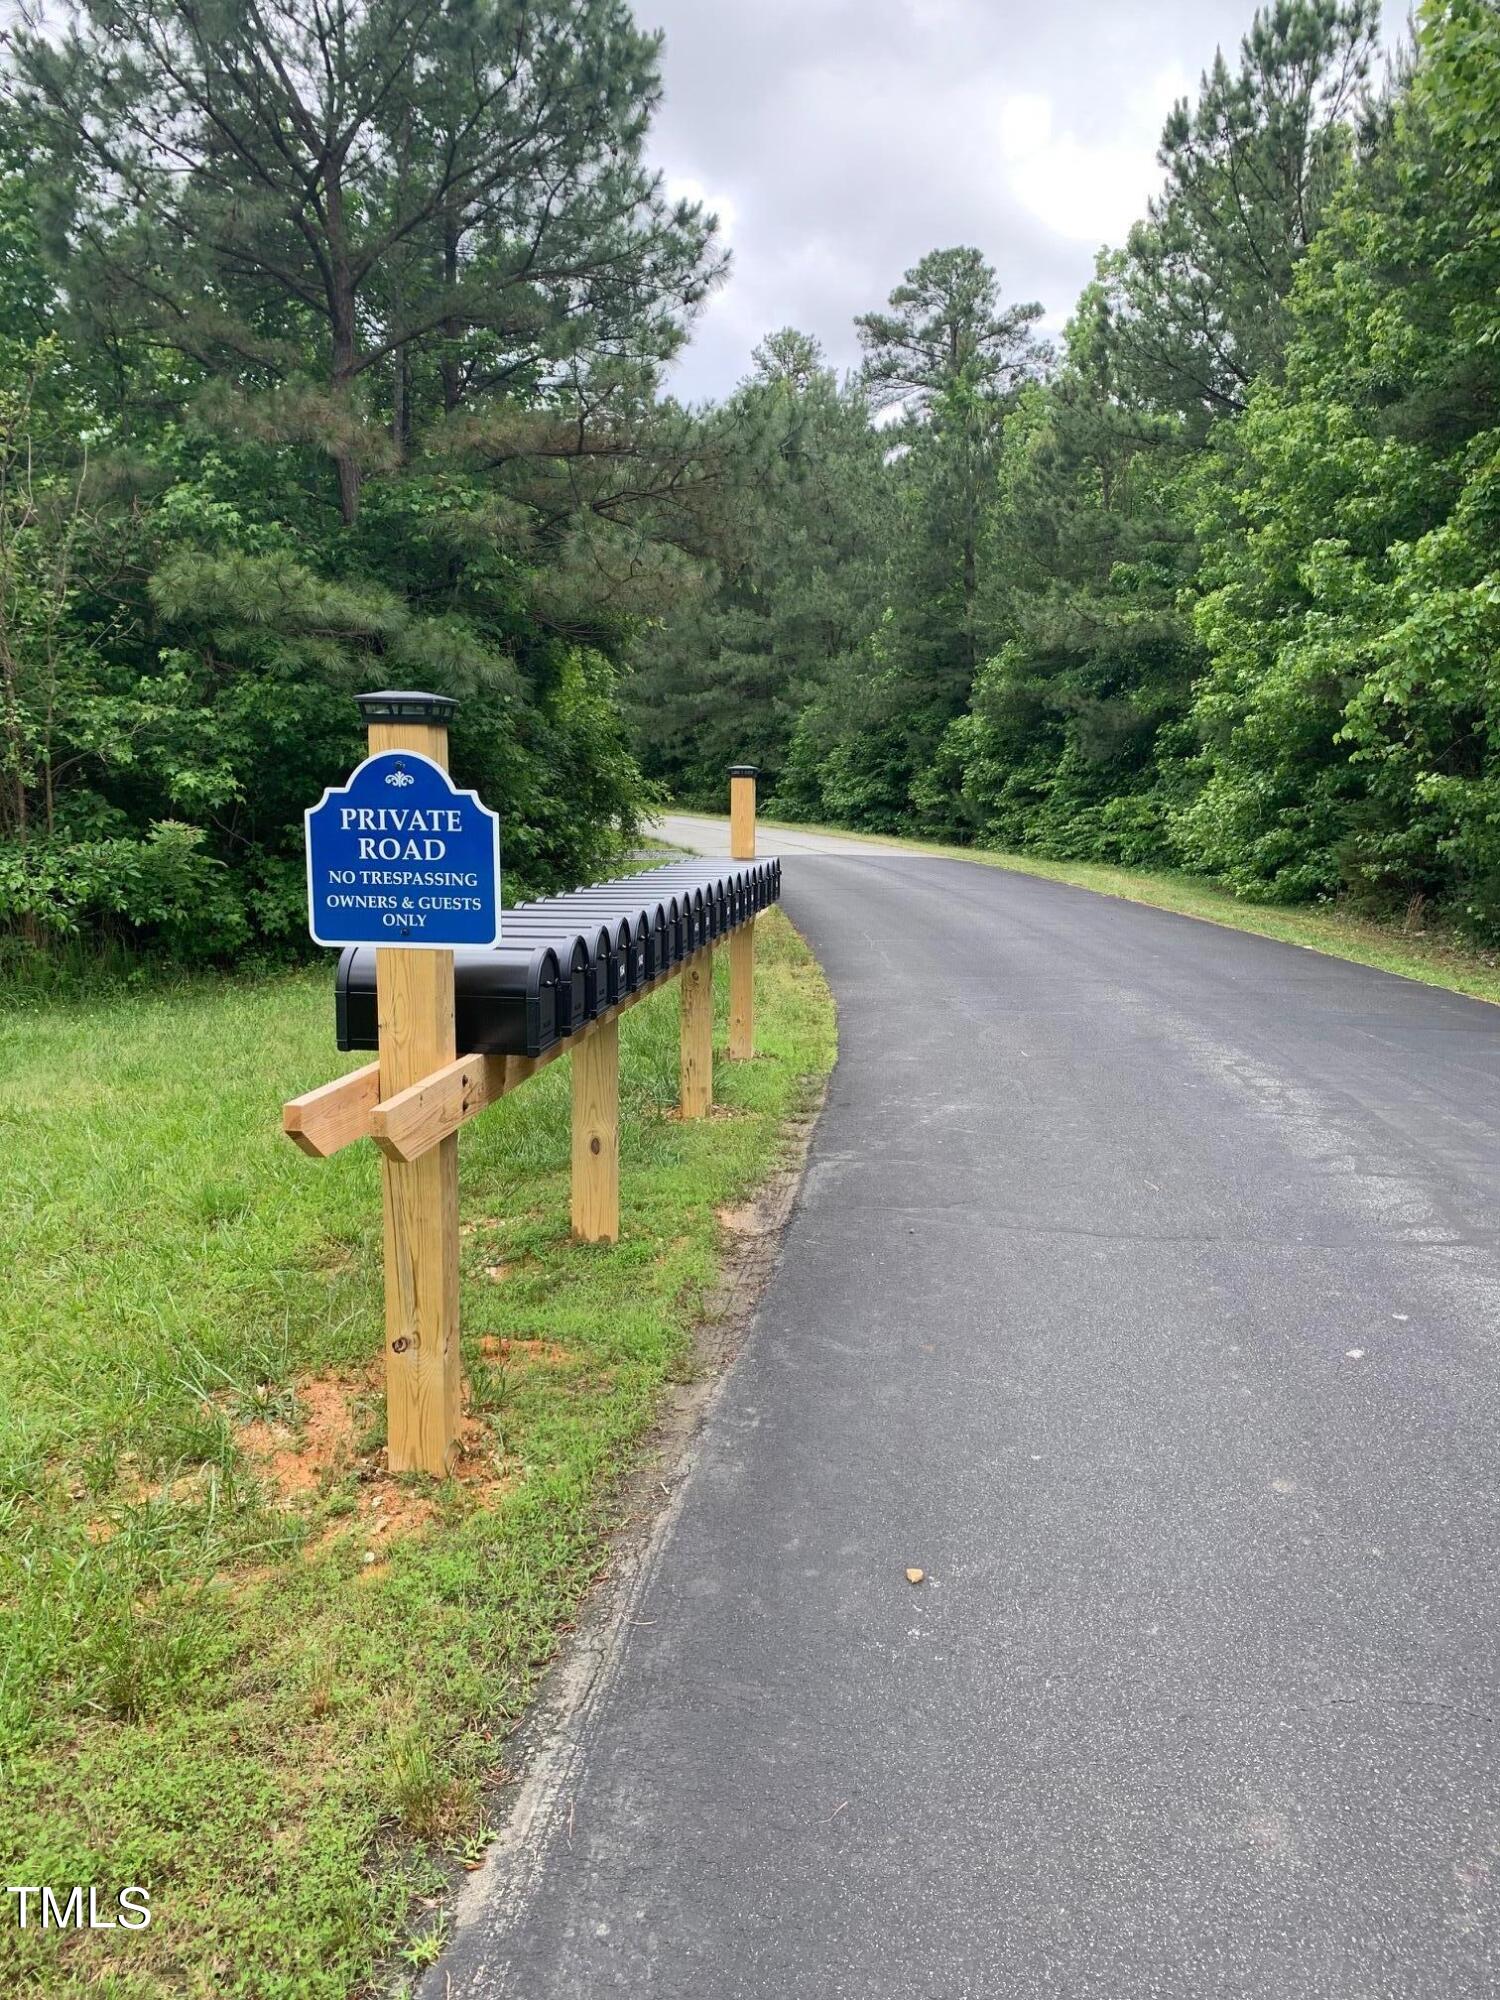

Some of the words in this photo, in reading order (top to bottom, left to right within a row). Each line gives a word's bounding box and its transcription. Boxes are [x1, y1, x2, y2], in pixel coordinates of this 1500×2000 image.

[340, 808, 462, 832] PRIVATE
[358, 837, 446, 861] ROAD
[328, 870, 356, 884] NO
[359, 871, 478, 887] TRESPASSING
[326, 894, 398, 909] OWNERS
[401, 897, 415, 909] &
[418, 896, 482, 911] GUESTS
[382, 913, 427, 927] ONLY
